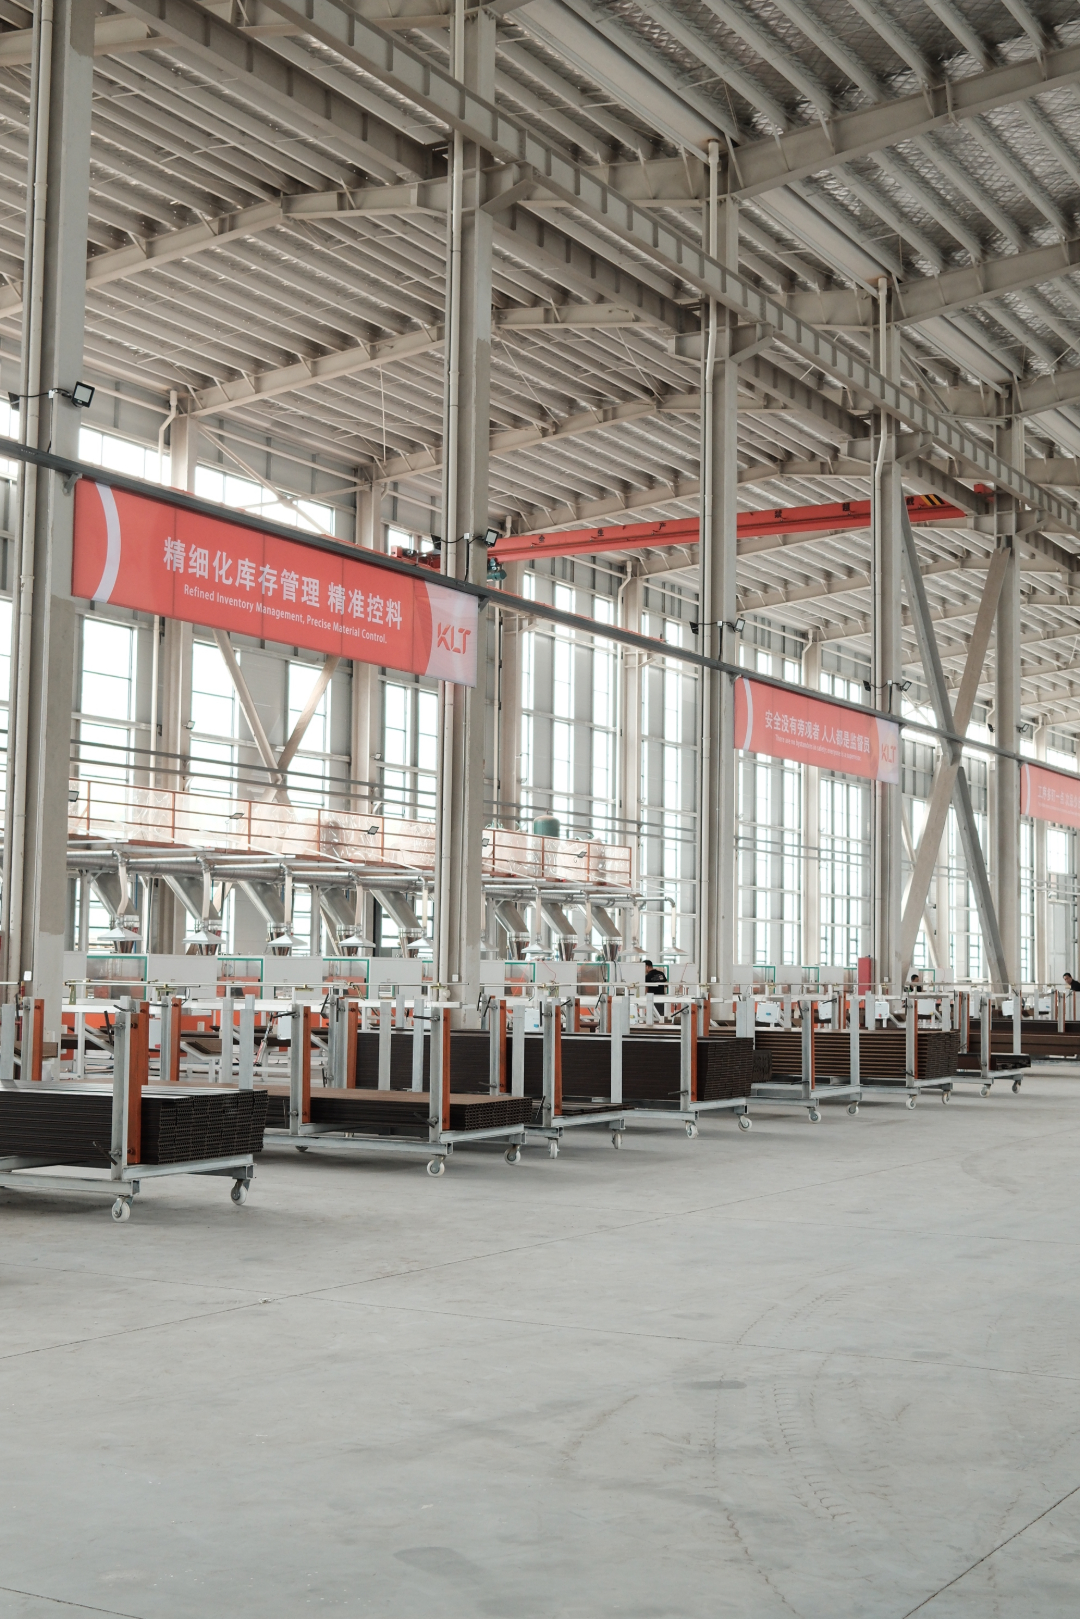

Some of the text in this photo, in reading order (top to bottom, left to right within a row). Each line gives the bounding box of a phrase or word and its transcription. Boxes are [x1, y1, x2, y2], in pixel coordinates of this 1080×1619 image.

[163, 536, 403, 631] 精细化库存管理 精准控料
[184, 584, 387, 644] Refined Inventory Management, Precise Material Control.
[437, 622, 472, 655] KLT
[765, 710, 871, 753] 安全没有旁观者 人人都是监督员
[881, 743, 897, 764] KLT
